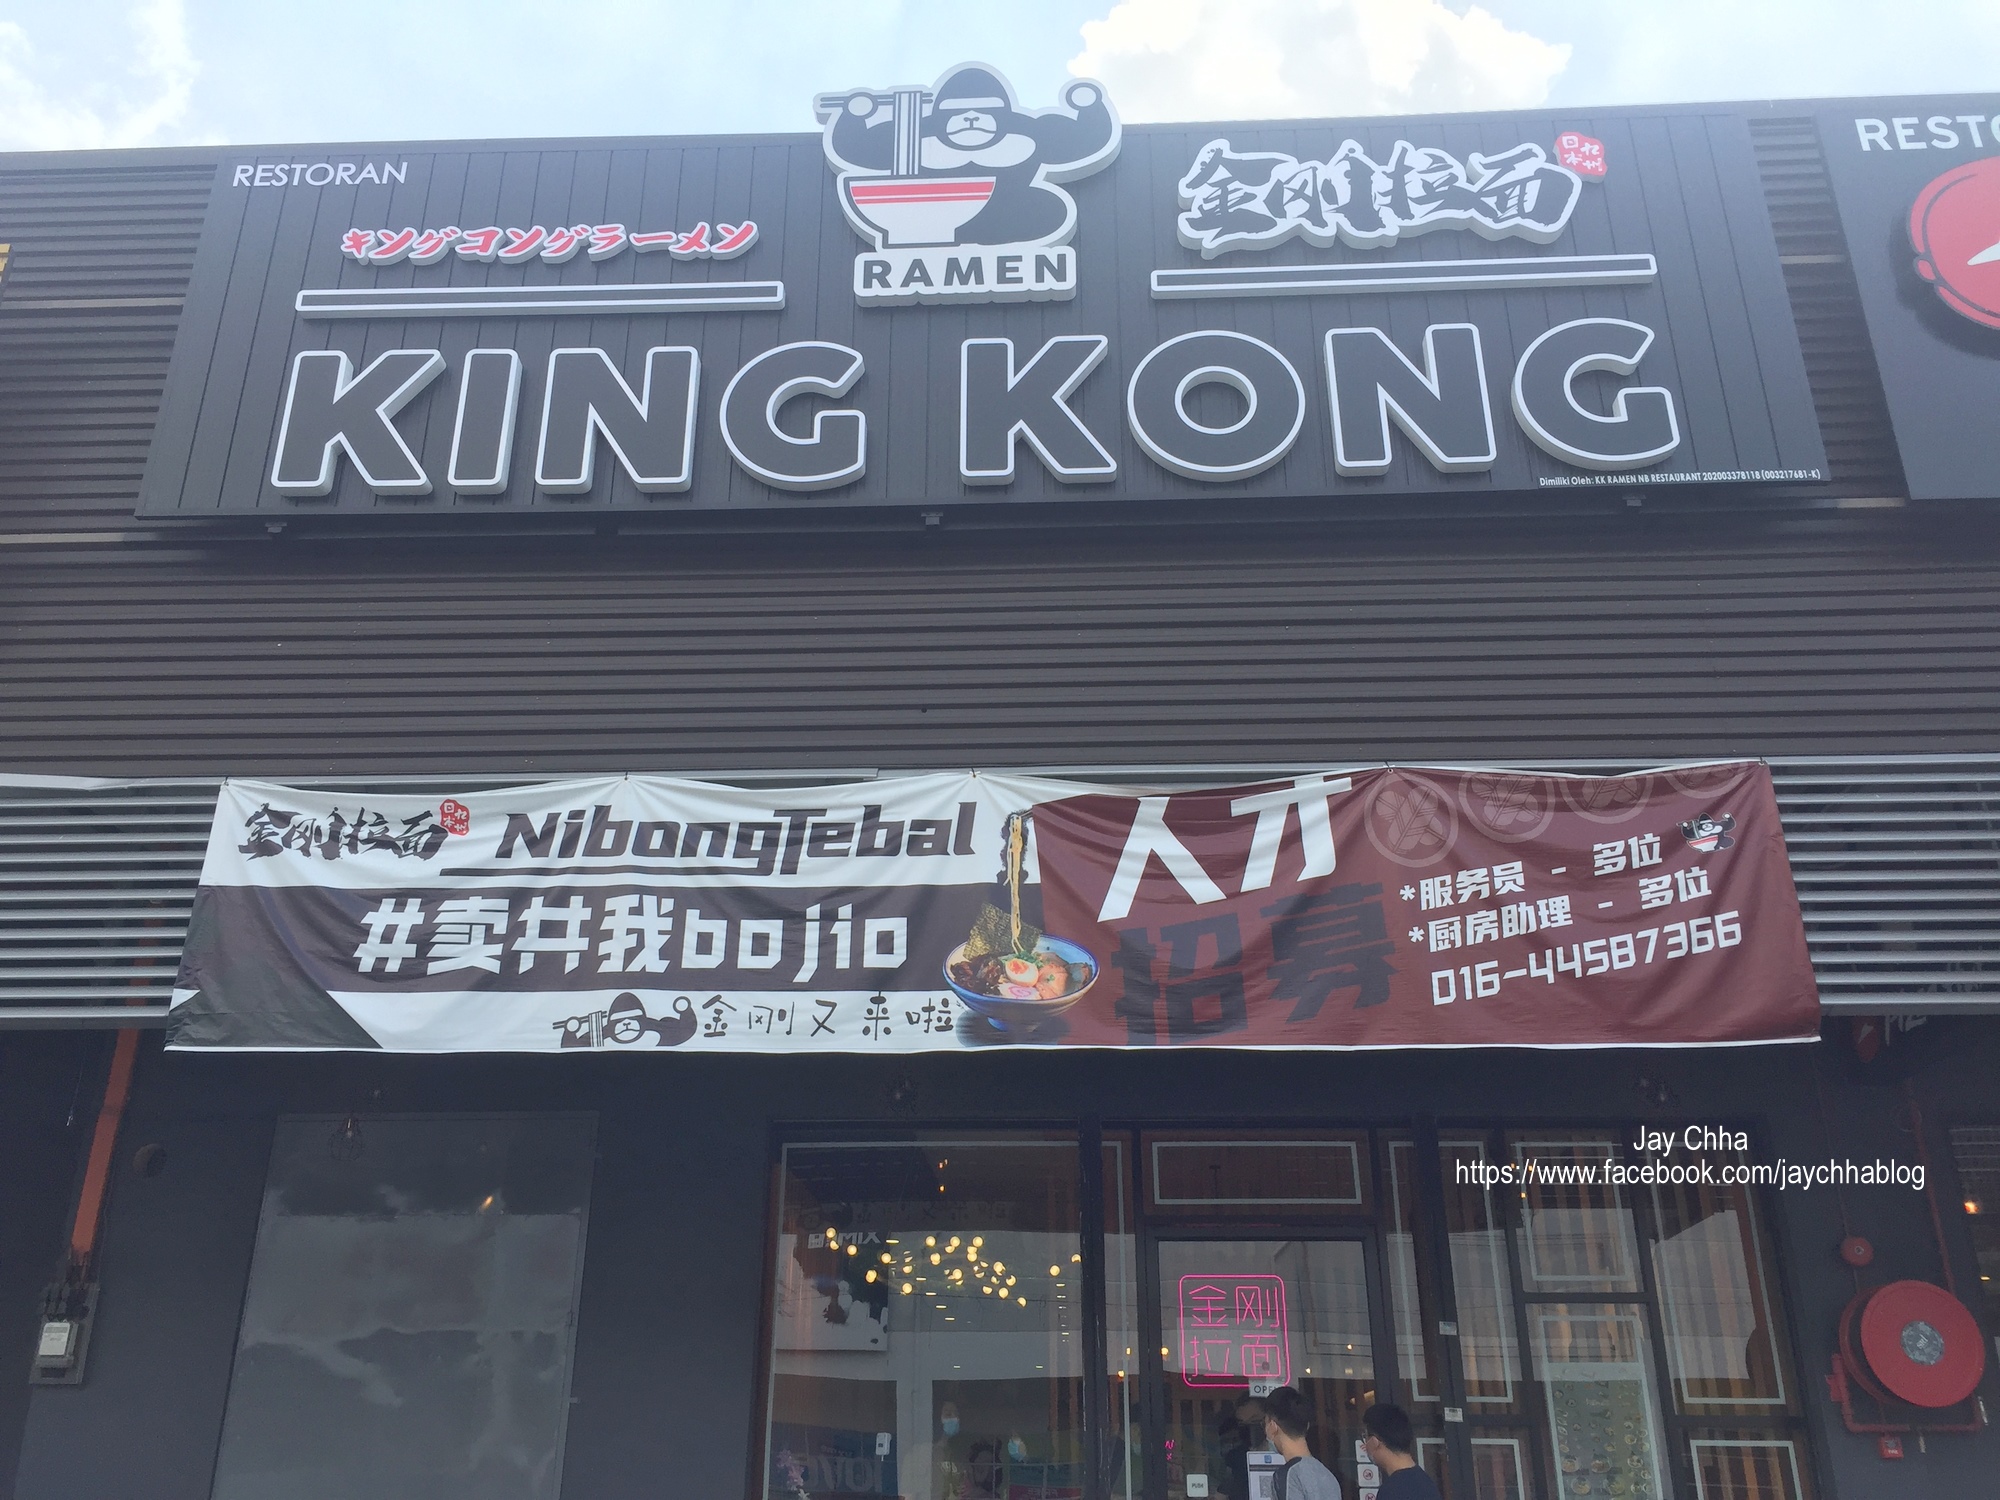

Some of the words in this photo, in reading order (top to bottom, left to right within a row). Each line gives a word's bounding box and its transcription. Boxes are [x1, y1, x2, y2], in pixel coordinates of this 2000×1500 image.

[1854, 114, 2000, 152] REST
[233, 161, 408, 188] RESTORAN
[1180, 142, 1580, 244] 金刚拉面
[340, 221, 759, 264] キングコングラーメン
[862, 253, 1069, 289] RAMEN
[270, 340, 867, 495] KING
[958, 317, 1681, 486] KONG
[1539, 476, 1570, 486] Dimiliki
[1571, 475, 1595, 486] Oleh:
[1595, 474, 1607, 485] KK
[1607, 474, 1637, 484] RAMEN
[1638, 473, 1650, 483] NB
[1651, 472, 1701, 483] RESTAURANT
[1702, 470, 1761, 481] 202003378118
[238, 804, 448, 861] 金刚拉面
[1097, 774, 1352, 922] 人才
[1592, 833, 1663, 877] 多位
[1639, 866, 1712, 910] 多位
[1430, 910, 1743, 1007] 016-44587366
[1189, 1285, 1279, 1328] 金刚
[1190, 1334, 1281, 1377] 拉面
[1253, 1385, 1278, 1394] OPE
